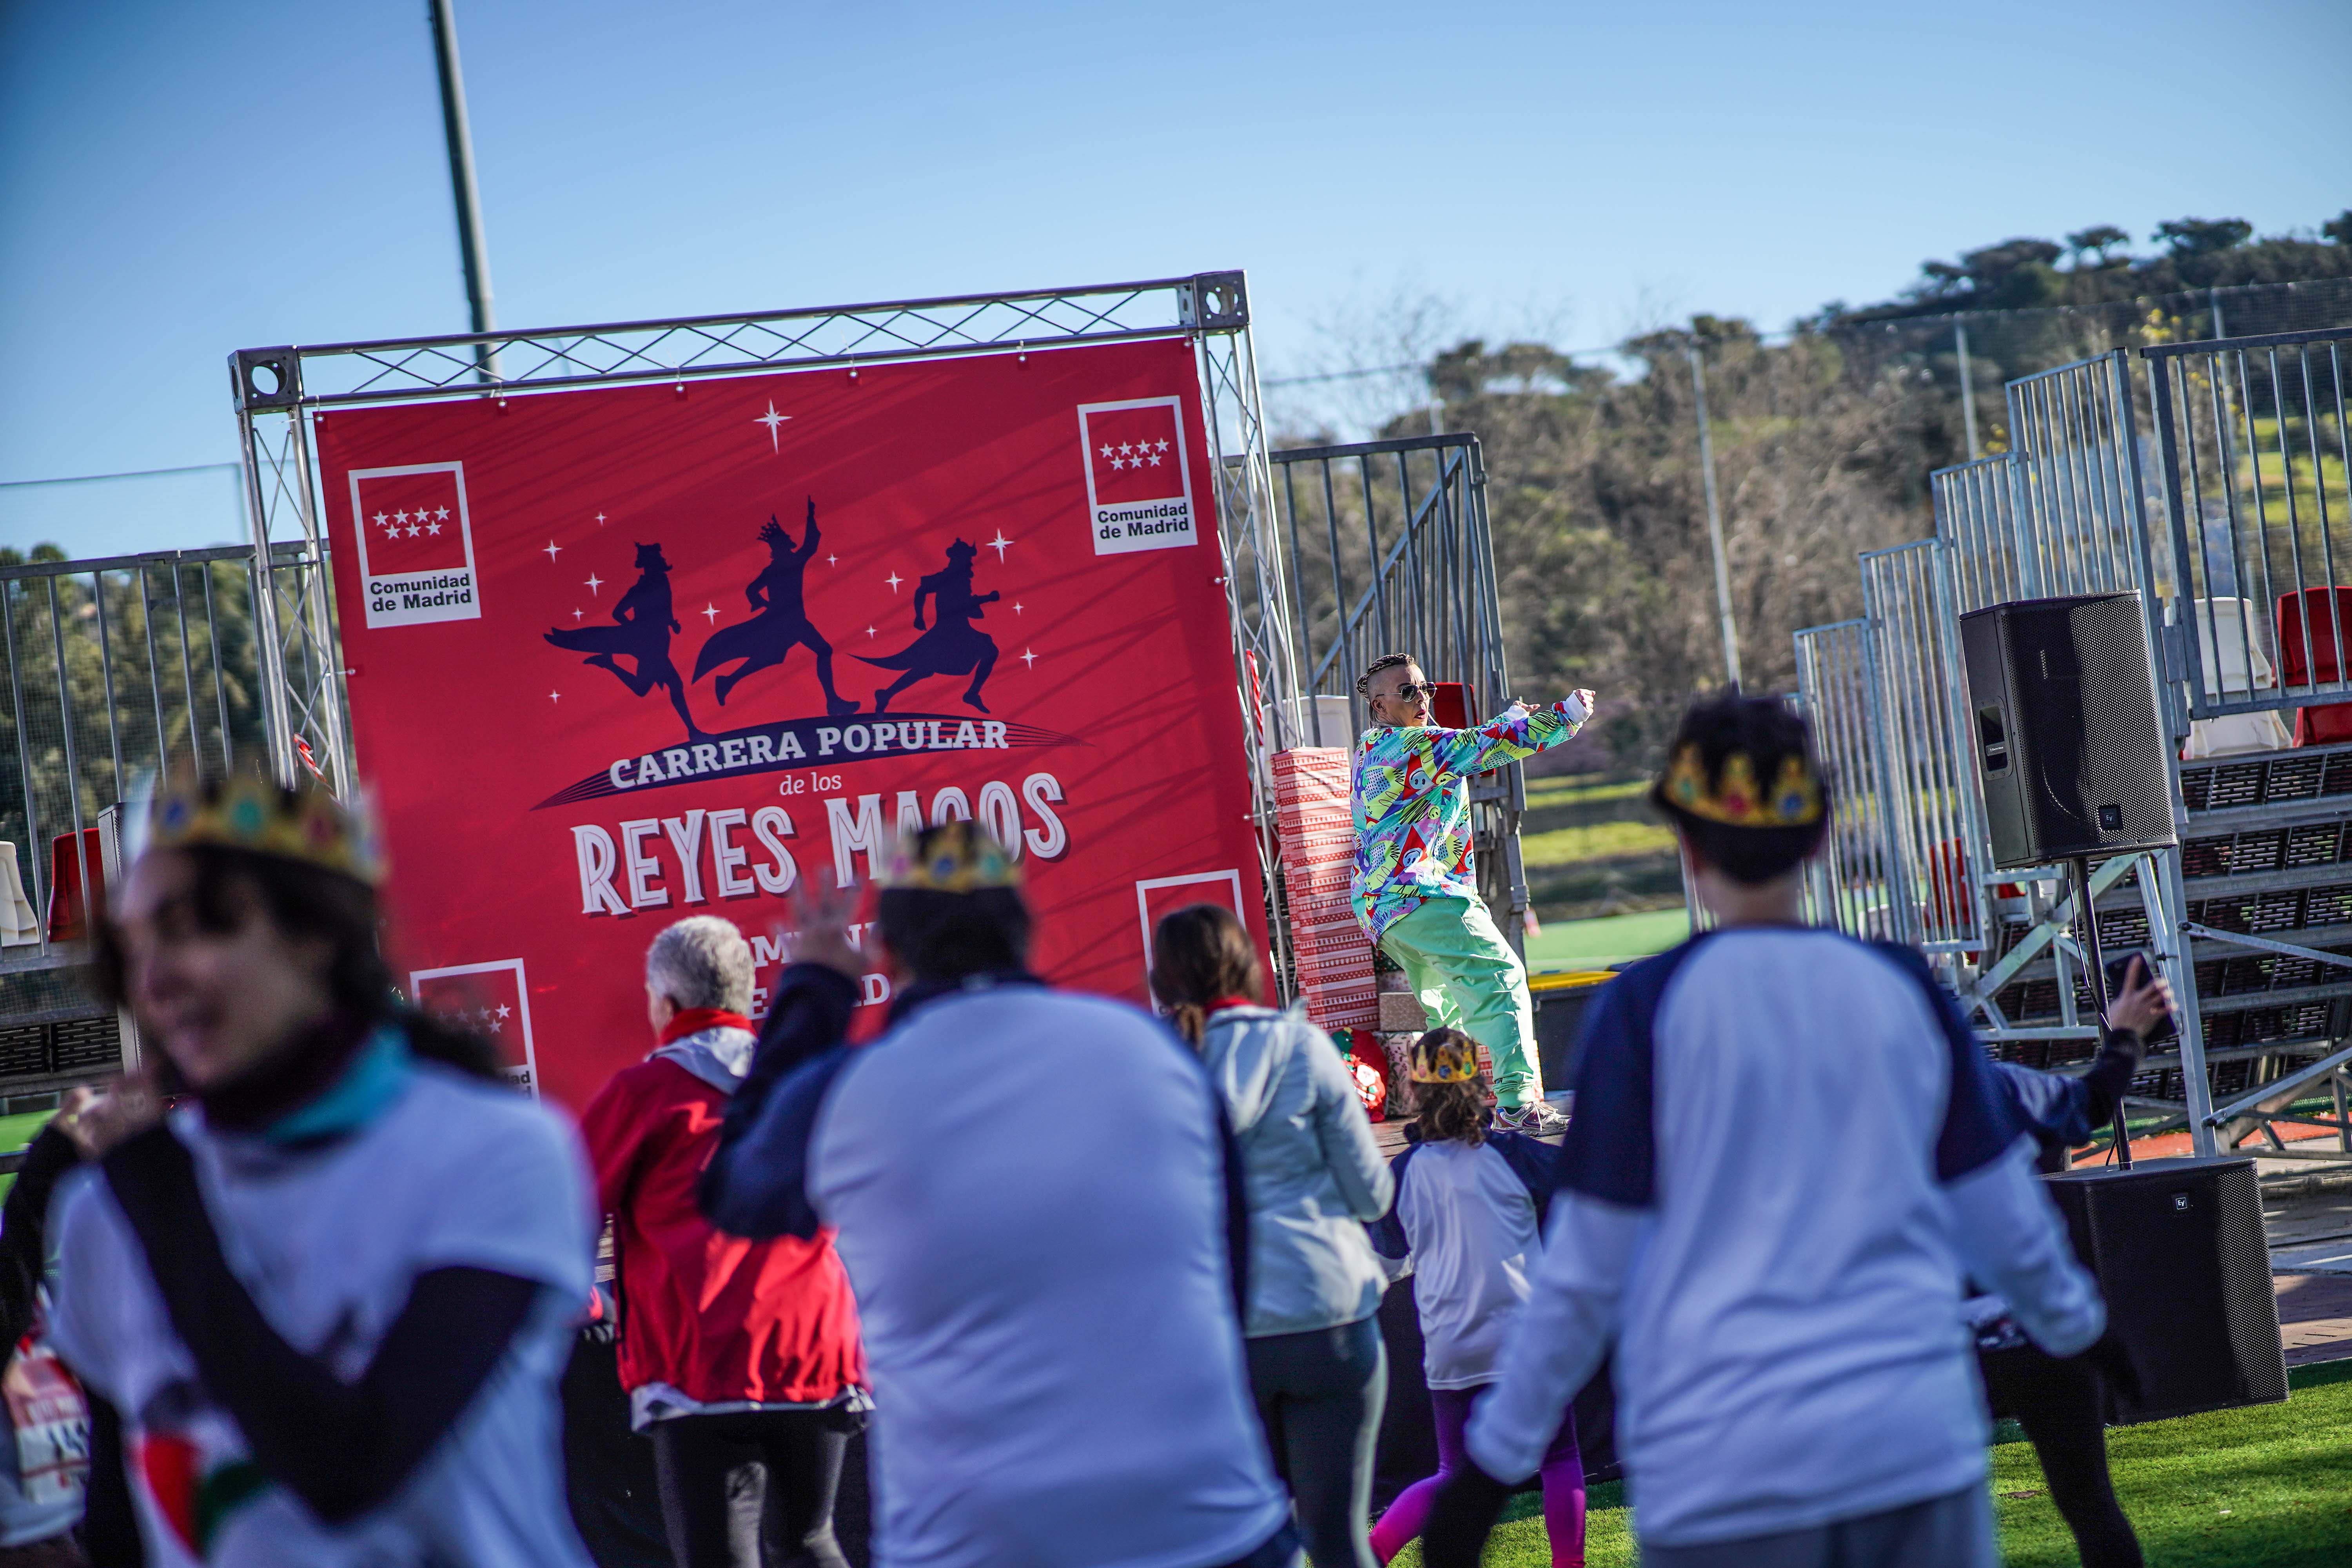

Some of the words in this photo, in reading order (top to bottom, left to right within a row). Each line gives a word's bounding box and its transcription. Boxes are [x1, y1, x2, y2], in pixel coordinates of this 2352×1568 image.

[1098, 503, 1187, 523] Comunidad
[1100, 526, 1121, 539] de
[1128, 518, 1189, 537] Madrid
[370, 573, 470, 594] Comunidad
[372, 597, 396, 612] de
[404, 590, 471, 609] Madrid
[610, 731, 806, 789] CARRERA
[816, 721, 1009, 756] POPULAR
[780, 774, 804, 795] de
[811, 772, 842, 792] los
[570, 806, 797, 915] REYES
